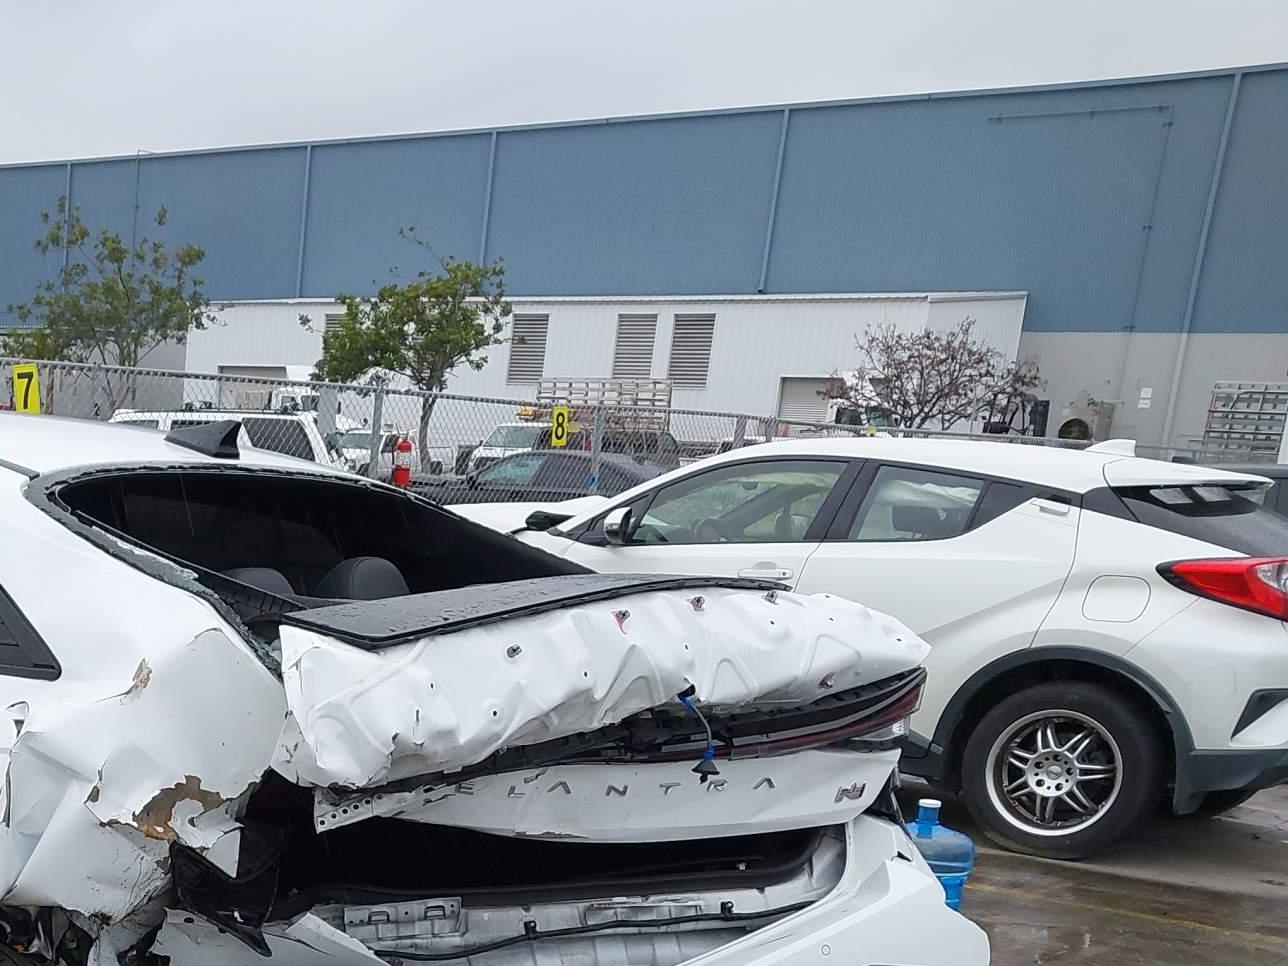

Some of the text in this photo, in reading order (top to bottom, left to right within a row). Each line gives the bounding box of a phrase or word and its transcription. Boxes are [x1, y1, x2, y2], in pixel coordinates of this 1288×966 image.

[16, 371, 35, 410] 7
[554, 411, 566, 441] 8
[455, 777, 776, 799] ELANTRA
